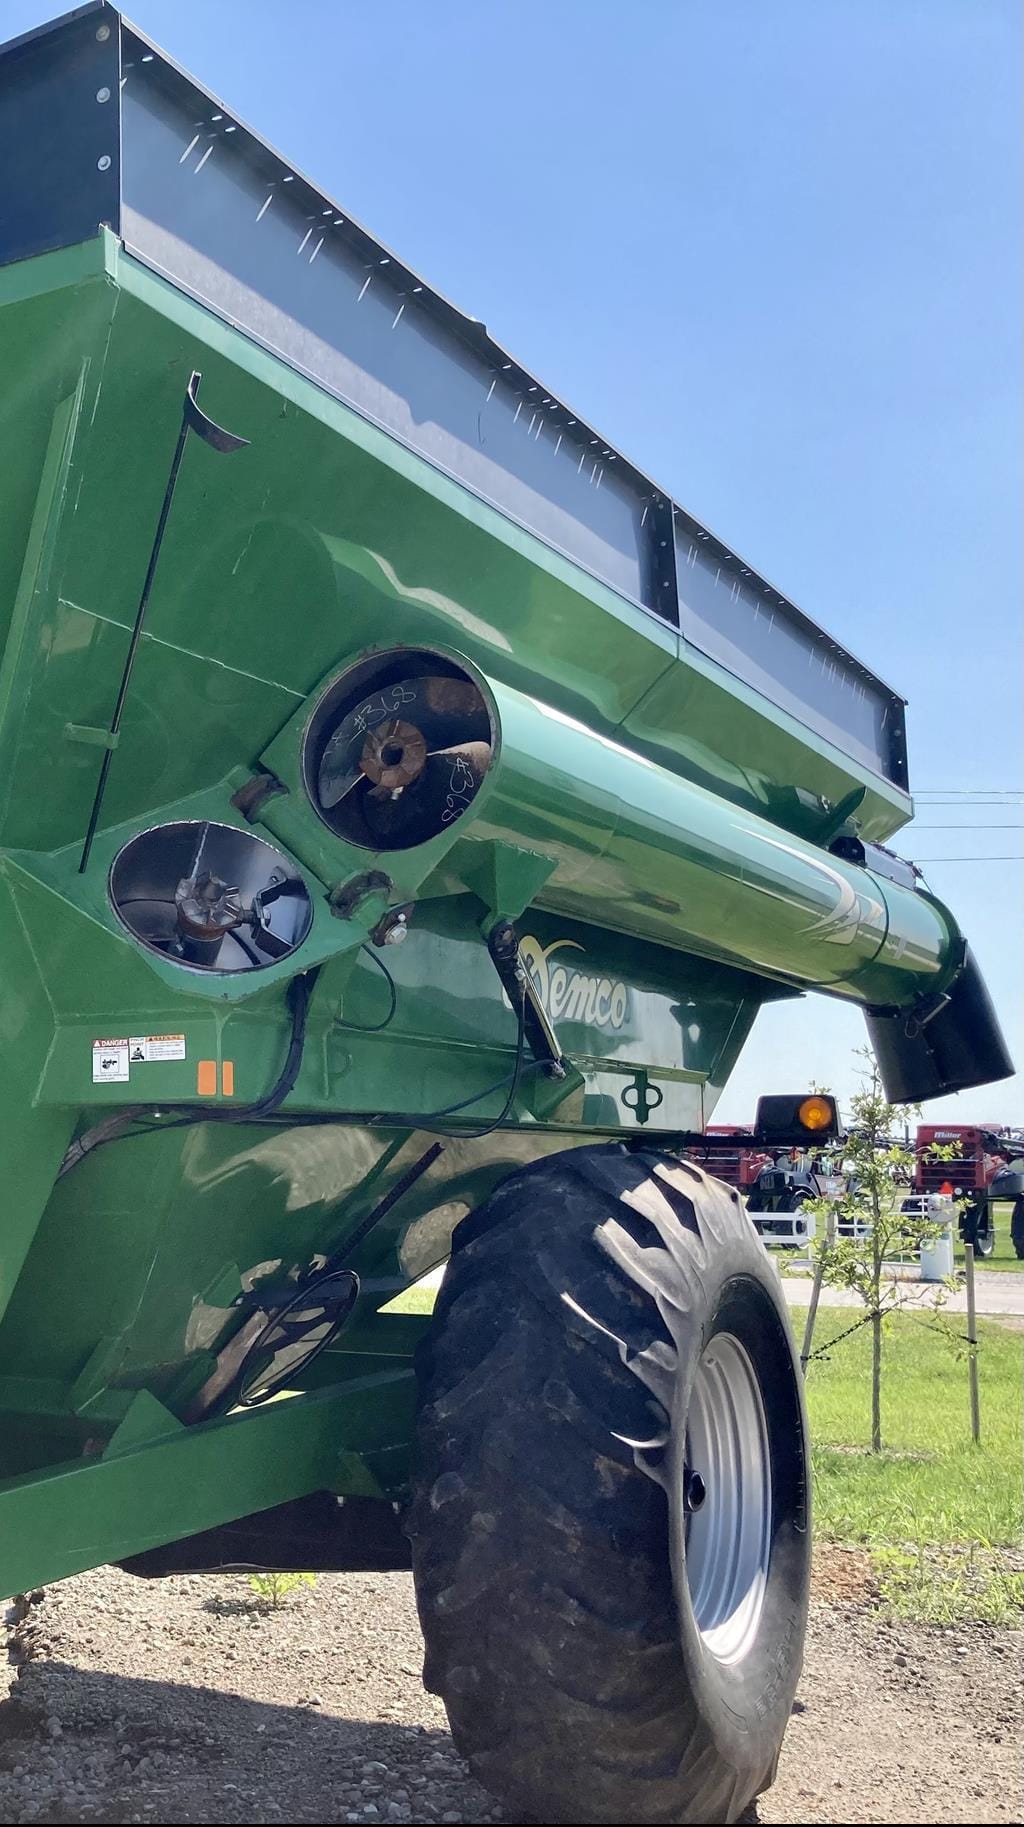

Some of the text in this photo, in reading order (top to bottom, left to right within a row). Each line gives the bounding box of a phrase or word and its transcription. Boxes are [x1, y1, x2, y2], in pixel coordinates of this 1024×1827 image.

[354, 686, 416, 730] #368
[502, 935, 627, 1029] Demco
[101, 1039, 128, 1047] DANGER
